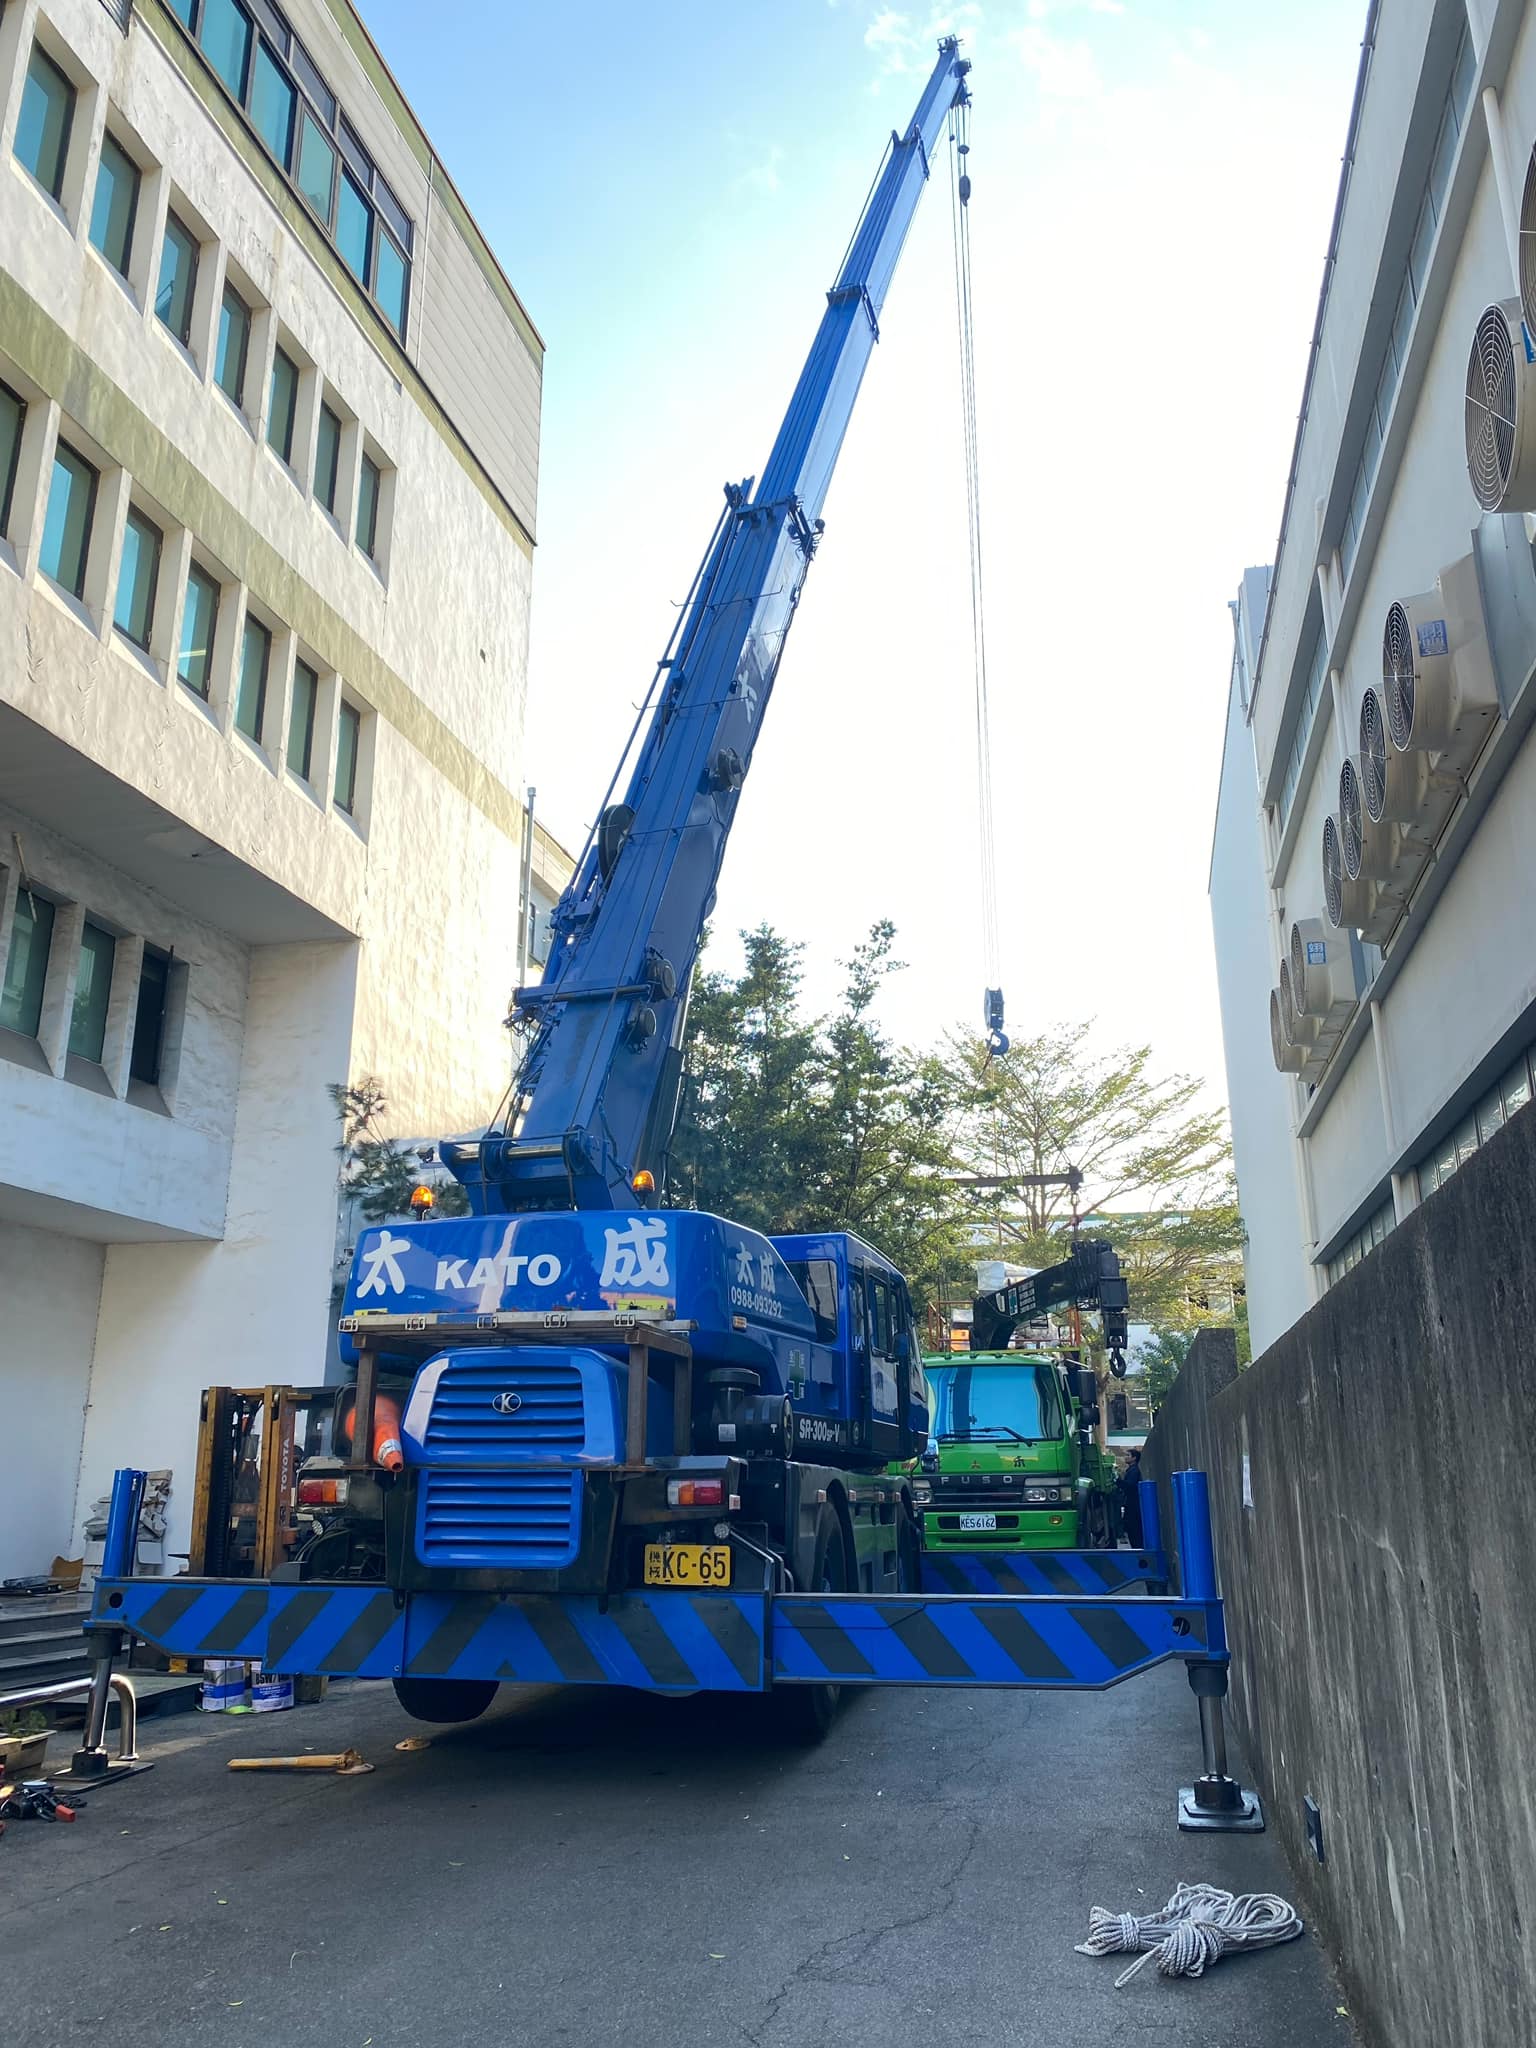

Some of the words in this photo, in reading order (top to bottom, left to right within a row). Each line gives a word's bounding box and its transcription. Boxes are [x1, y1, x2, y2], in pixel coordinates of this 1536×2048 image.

[356, 1230, 411, 1298] 太
[598, 1217, 670, 1287] 成
[435, 1254, 561, 1290] KATO
[731, 1285, 784, 1319] 0988-093292
[280, 1438, 291, 1493] TOYOTA
[940, 1475, 1013, 1485] FUSO
[662, 1551, 727, 1580] KC-65
